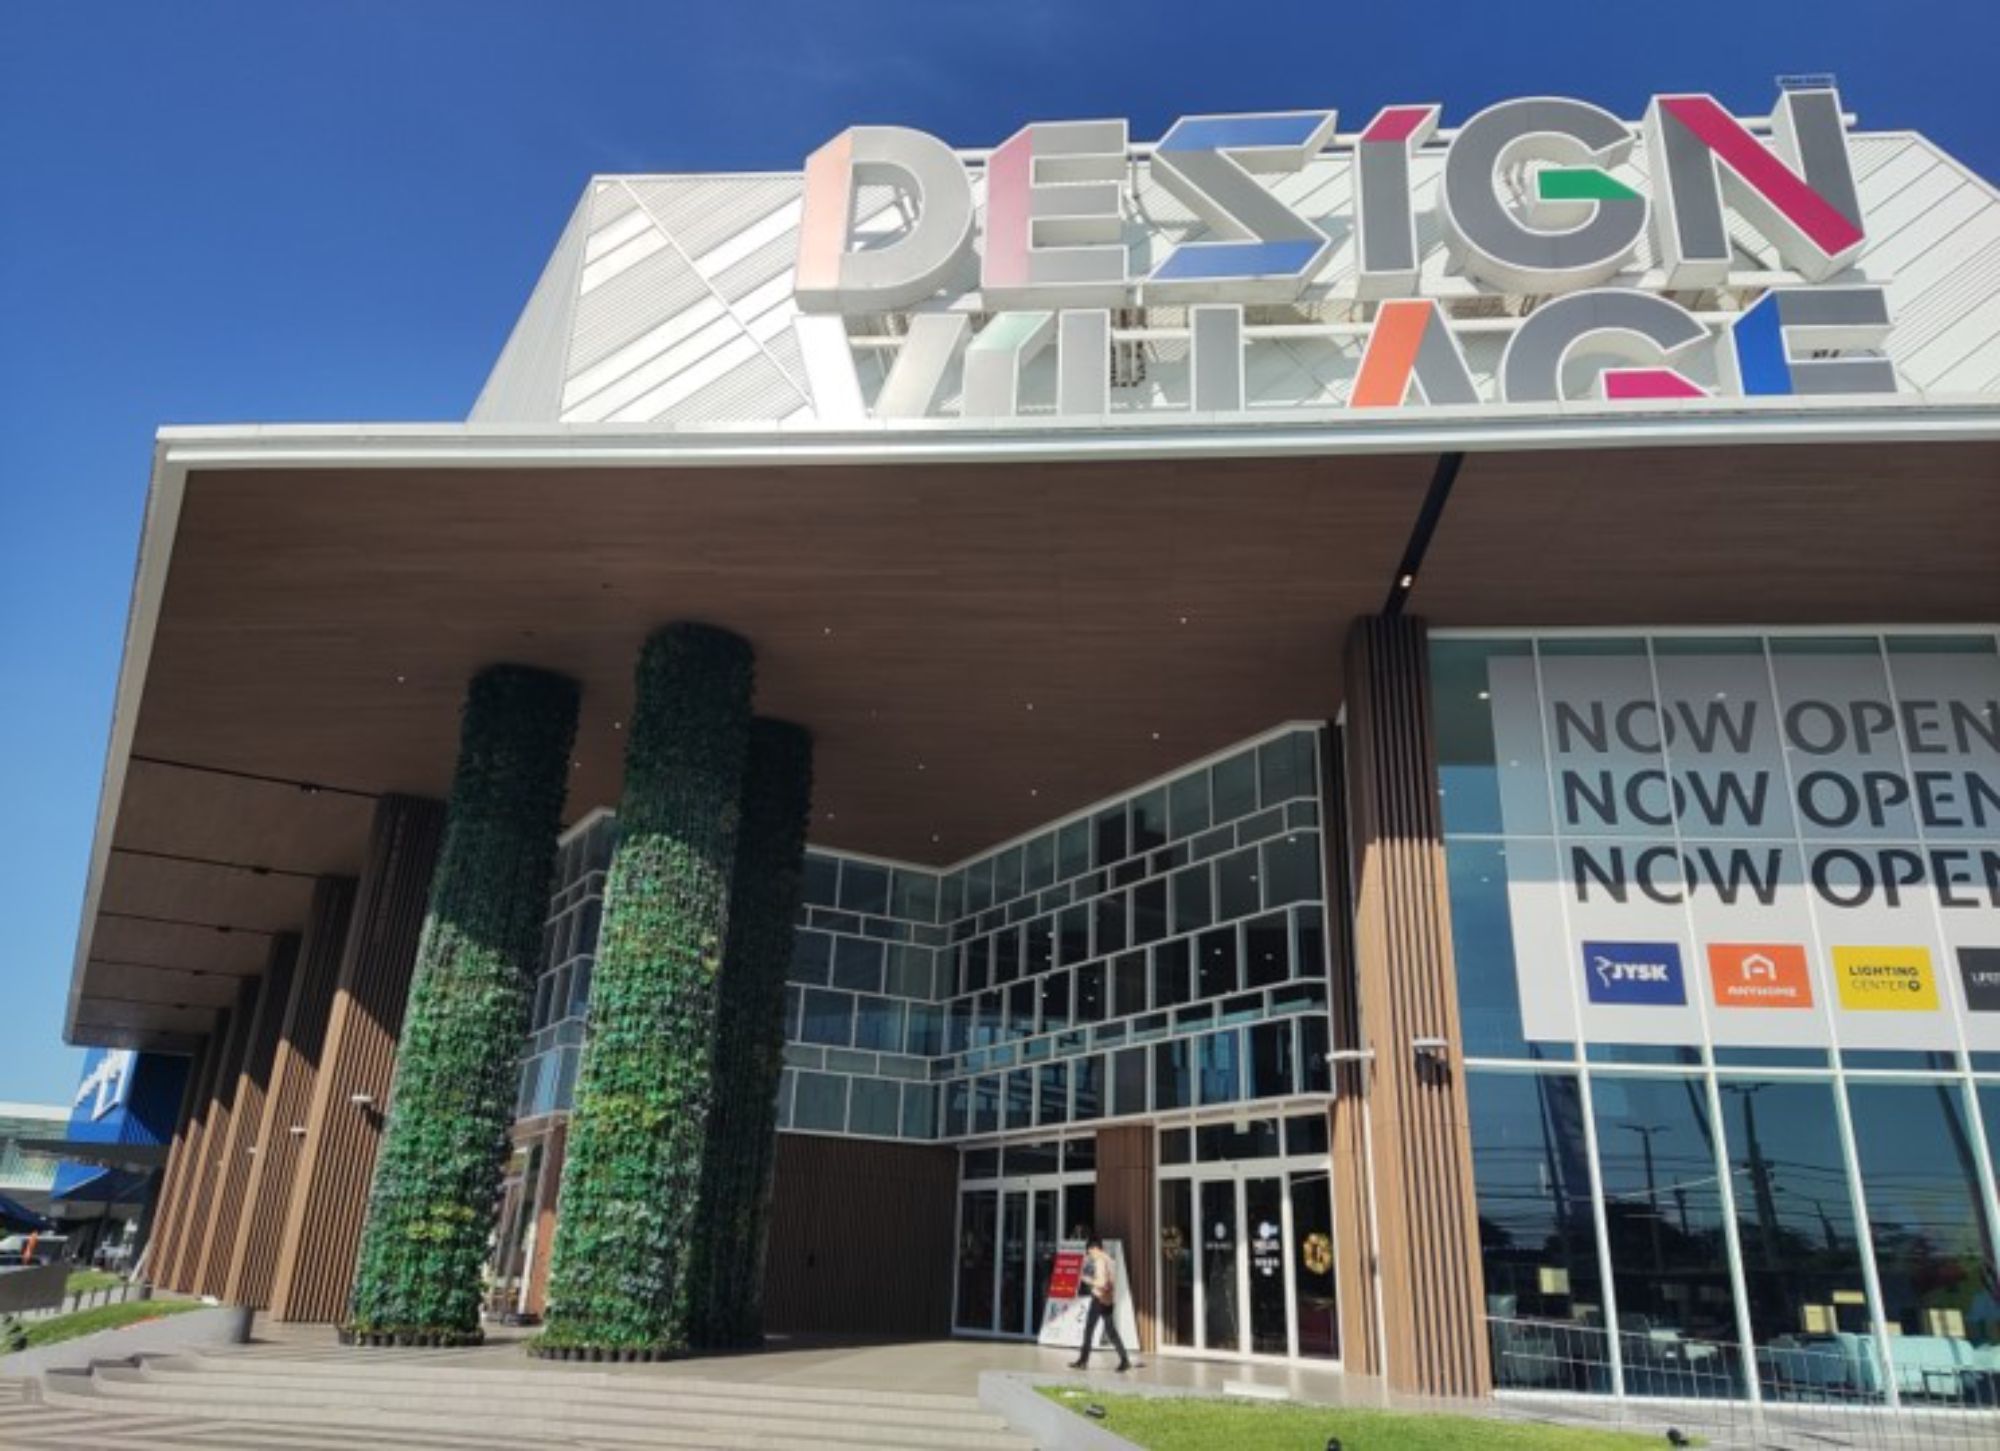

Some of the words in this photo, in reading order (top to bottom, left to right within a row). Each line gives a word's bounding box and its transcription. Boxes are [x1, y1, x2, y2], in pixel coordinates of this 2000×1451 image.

[794, 89, 1866, 314] DESIGN
[1554, 700, 1757, 754] NOW
[1784, 700, 2000, 755] OPEN
[1561, 770, 1770, 826] NOW
[1570, 846, 1783, 906] NOW
[1611, 962, 1669, 982] JYSK
[1848, 964, 1919, 977] LIGHTING
[1851, 979, 1906, 993] CENTER
